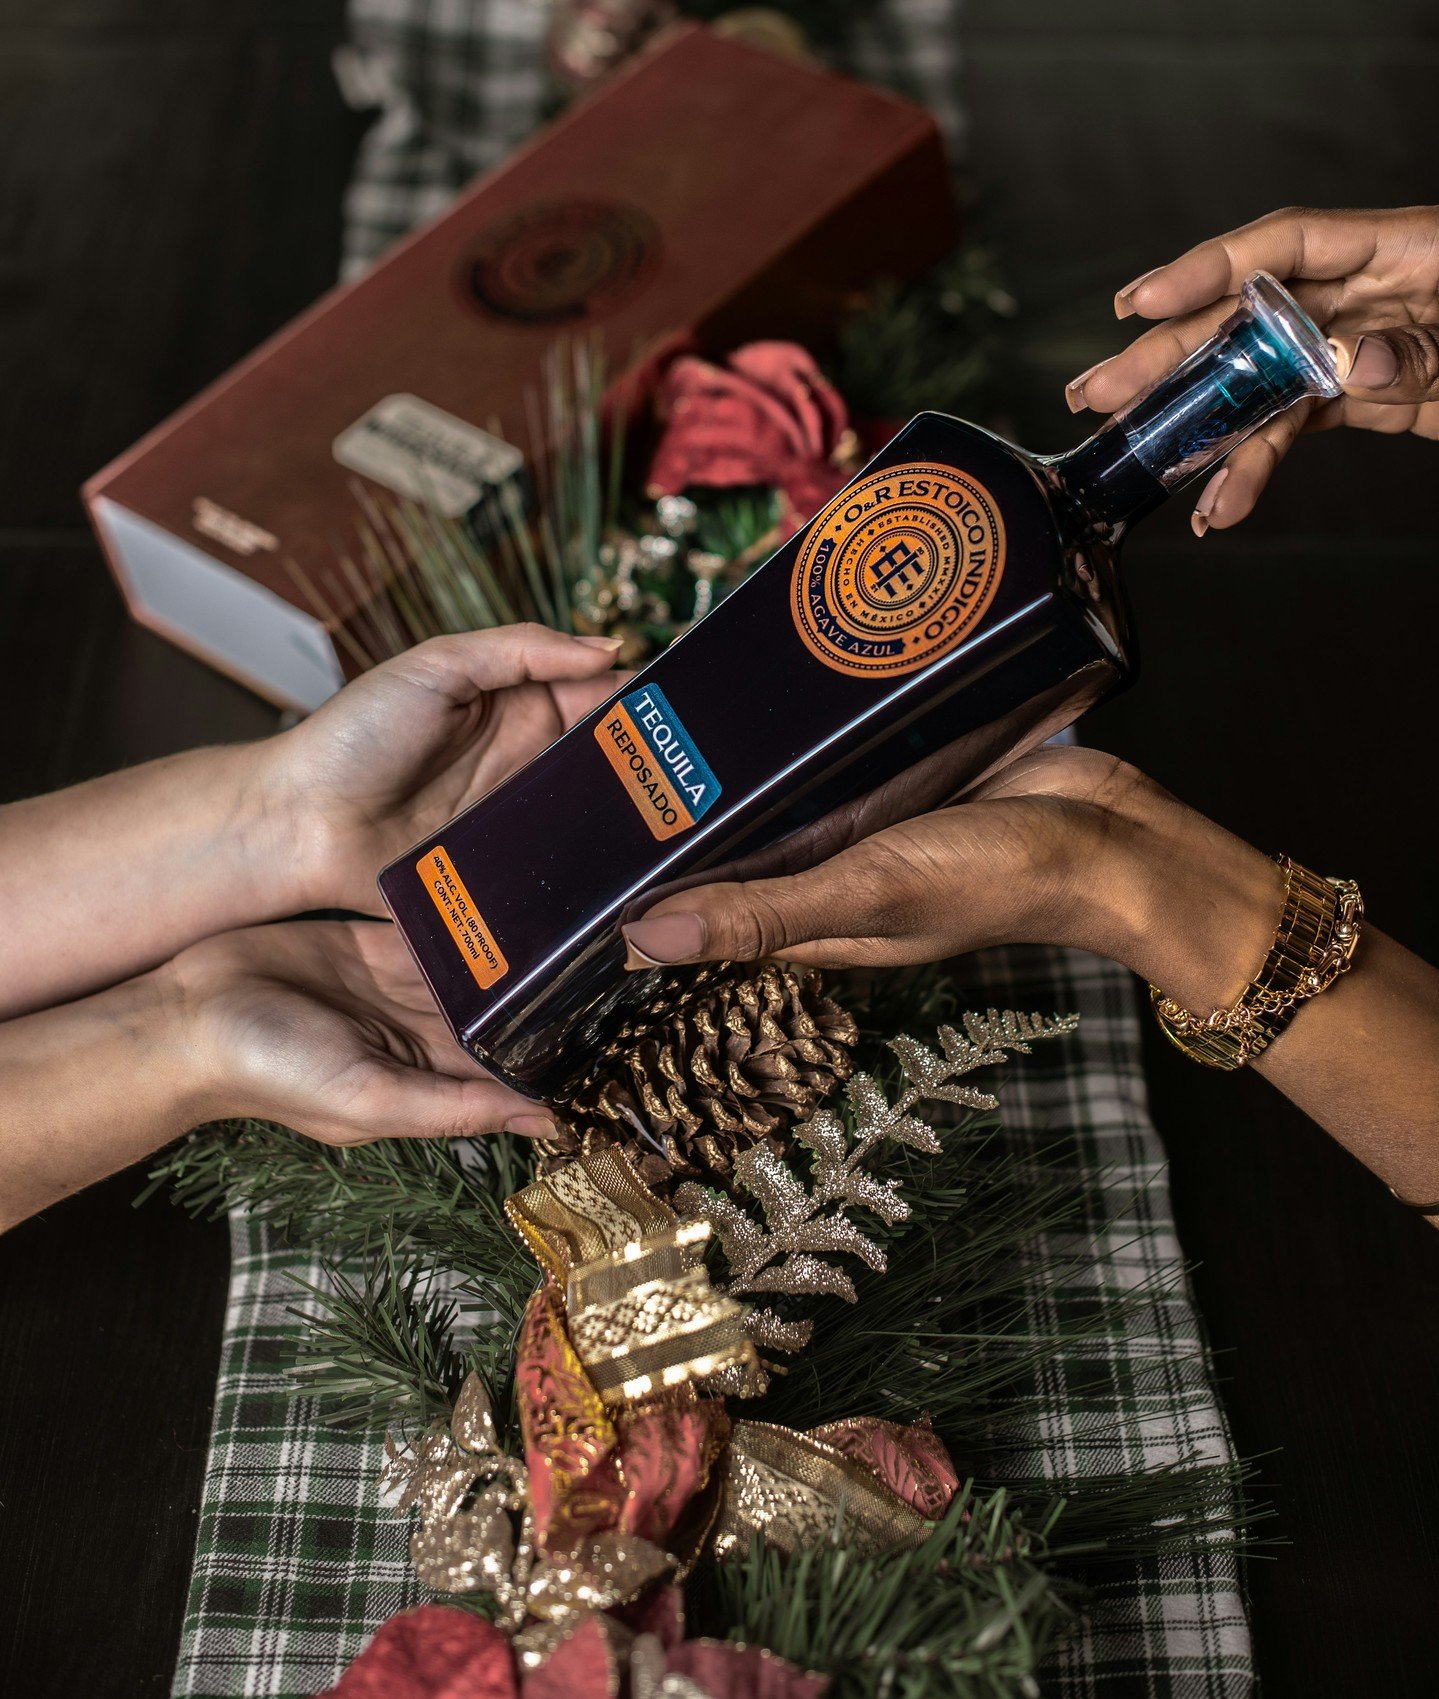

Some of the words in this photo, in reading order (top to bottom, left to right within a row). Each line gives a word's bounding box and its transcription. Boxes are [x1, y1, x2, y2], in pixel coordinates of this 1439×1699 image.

[844, 486, 892, 523] O&R
[899, 481, 985, 545] ESTOICO
[810, 545, 829, 588] 100%
[843, 538, 864, 586] HECHO
[878, 515, 950, 550] ESTABLISHED
[928, 556, 950, 599] MMXXI
[811, 594, 847, 645] AGAVE
[846, 593, 858, 608] EN
[860, 610, 913, 623] MÉXICO
[924, 550, 986, 640] INDIGO
[847, 642, 895, 656] AZUL
[606, 719, 678, 825] REPOSADO
[634, 692, 706, 807] TEQUILA
[433, 856, 446, 874] 40%
[442, 874, 457, 896] ALC.
[466, 916, 479, 933] (80
[474, 932, 498, 970] PROOF)
[434, 880, 452, 910] CONT.
[449, 909, 464, 932] NET.
[461, 930, 480, 960] 700ml
